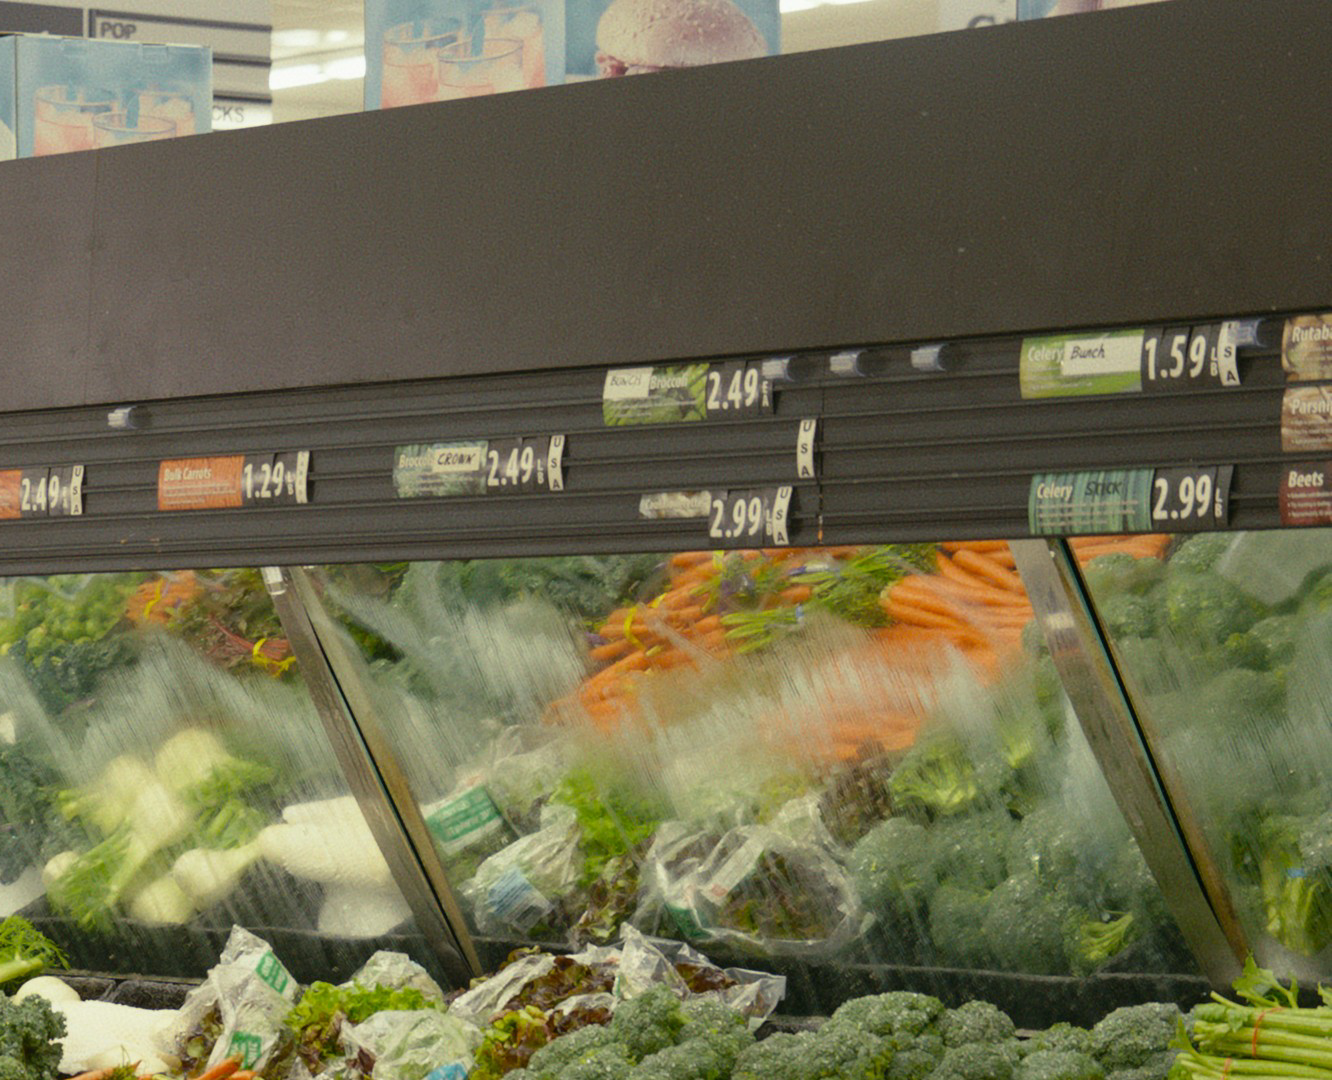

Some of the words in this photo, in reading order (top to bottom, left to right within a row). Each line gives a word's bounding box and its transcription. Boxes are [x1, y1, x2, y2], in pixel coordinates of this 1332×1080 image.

[100, 22, 137, 39] POP
[1145, 335, 1207, 380] 1.59
[707, 368, 759, 410] 2.49
[183, 467, 212, 480] Carrots
[244, 461, 285, 498] 1.29
[487, 446, 535, 486] 2.49
[1287, 469, 1325, 488] Beets
[21, 475, 60, 511] 2.49
[1036, 482, 1074, 501] Celery
[1153, 474, 1212, 520] 2.99
[709, 497, 762, 538] 2.99
